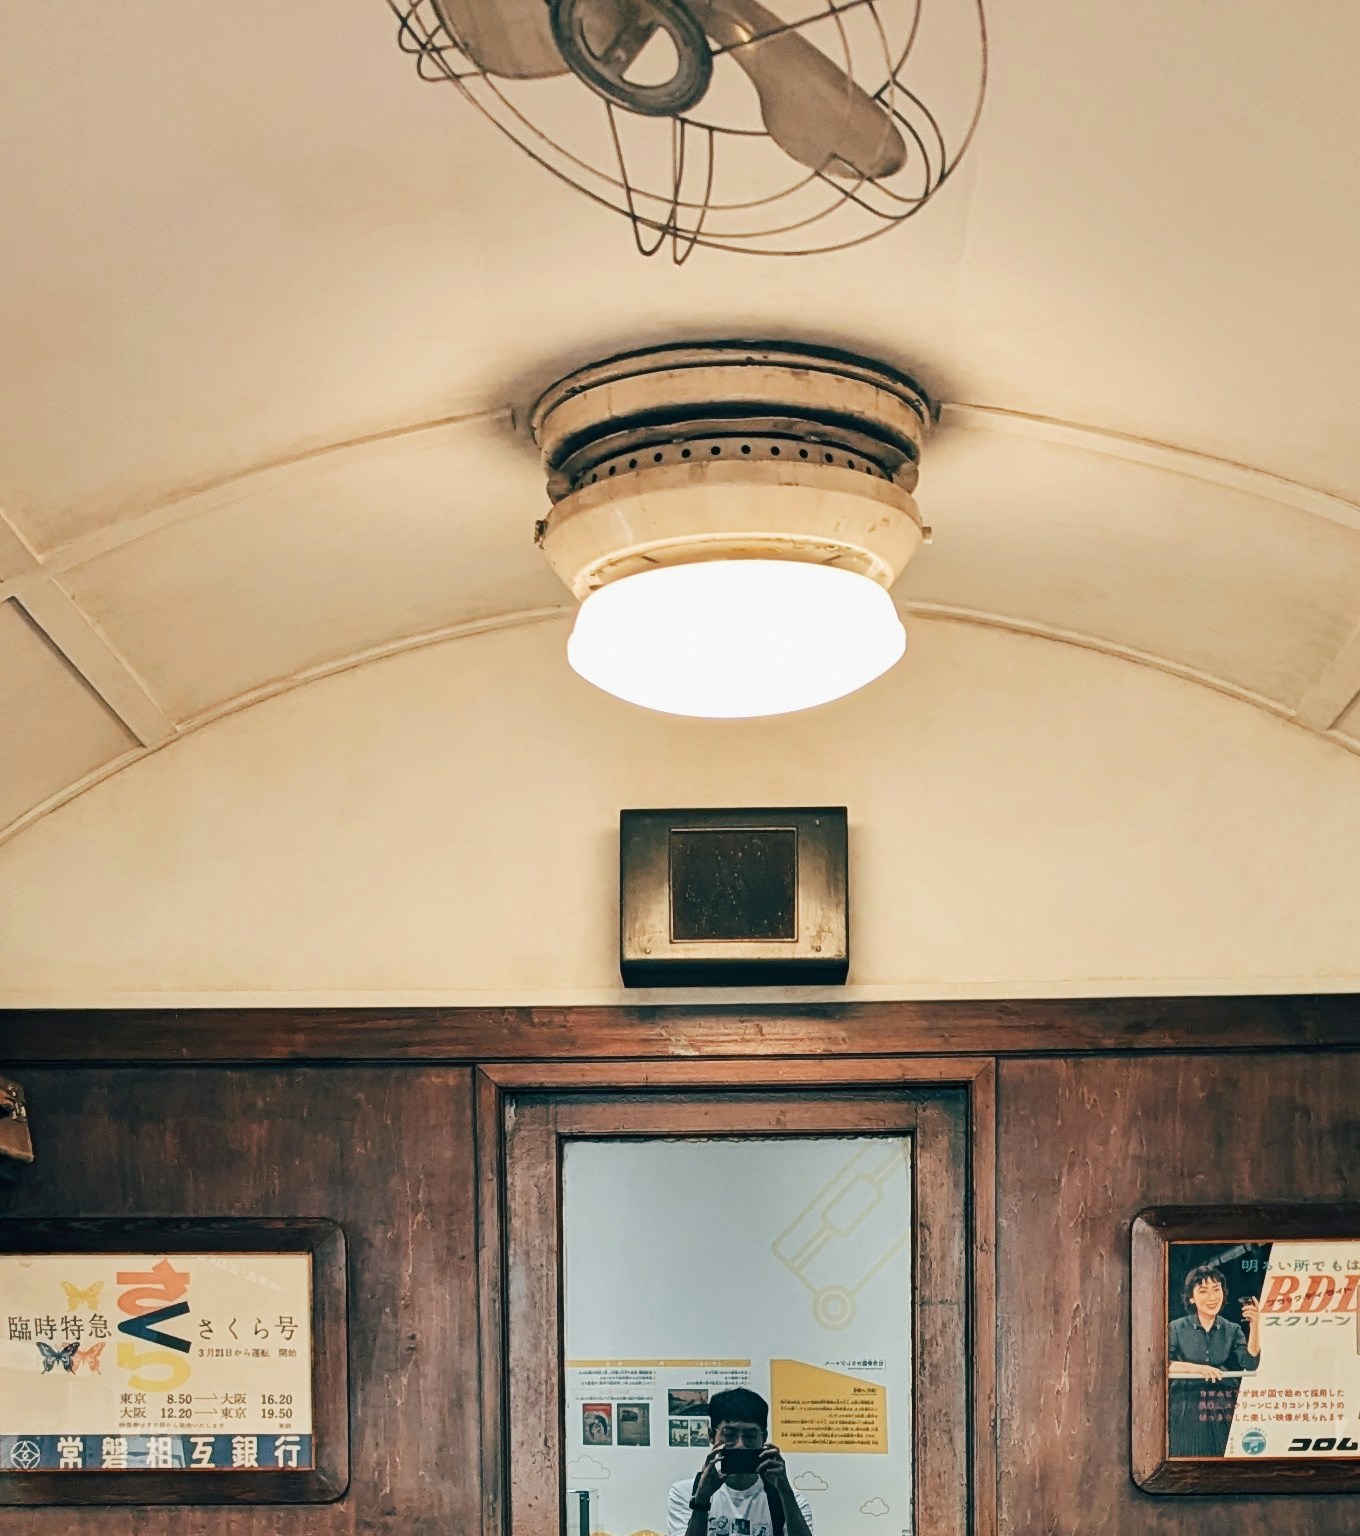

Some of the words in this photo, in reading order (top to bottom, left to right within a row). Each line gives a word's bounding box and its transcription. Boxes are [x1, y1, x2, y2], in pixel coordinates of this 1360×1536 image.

[7, 1313, 112, 1341] 臨時特急
[198, 1315, 298, 1341] さくら号
[116, 1258, 192, 1393] さくら
[1265, 1316, 1351, 1327] スクリーン
[119, 1393, 147, 1405] 東京
[167, 1394, 192, 1404] 8.50
[221, 1393, 247, 1405] 大阪
[261, 1394, 293, 1405] 16.20
[119, 1407, 147, 1419] 大阪
[160, 1408, 192, 1419] 12.20
[221, 1407, 247, 1419] 東京
[261, 1408, 293, 1419] 19.50
[57, 1436, 302, 1469] 常磐相互銀行
